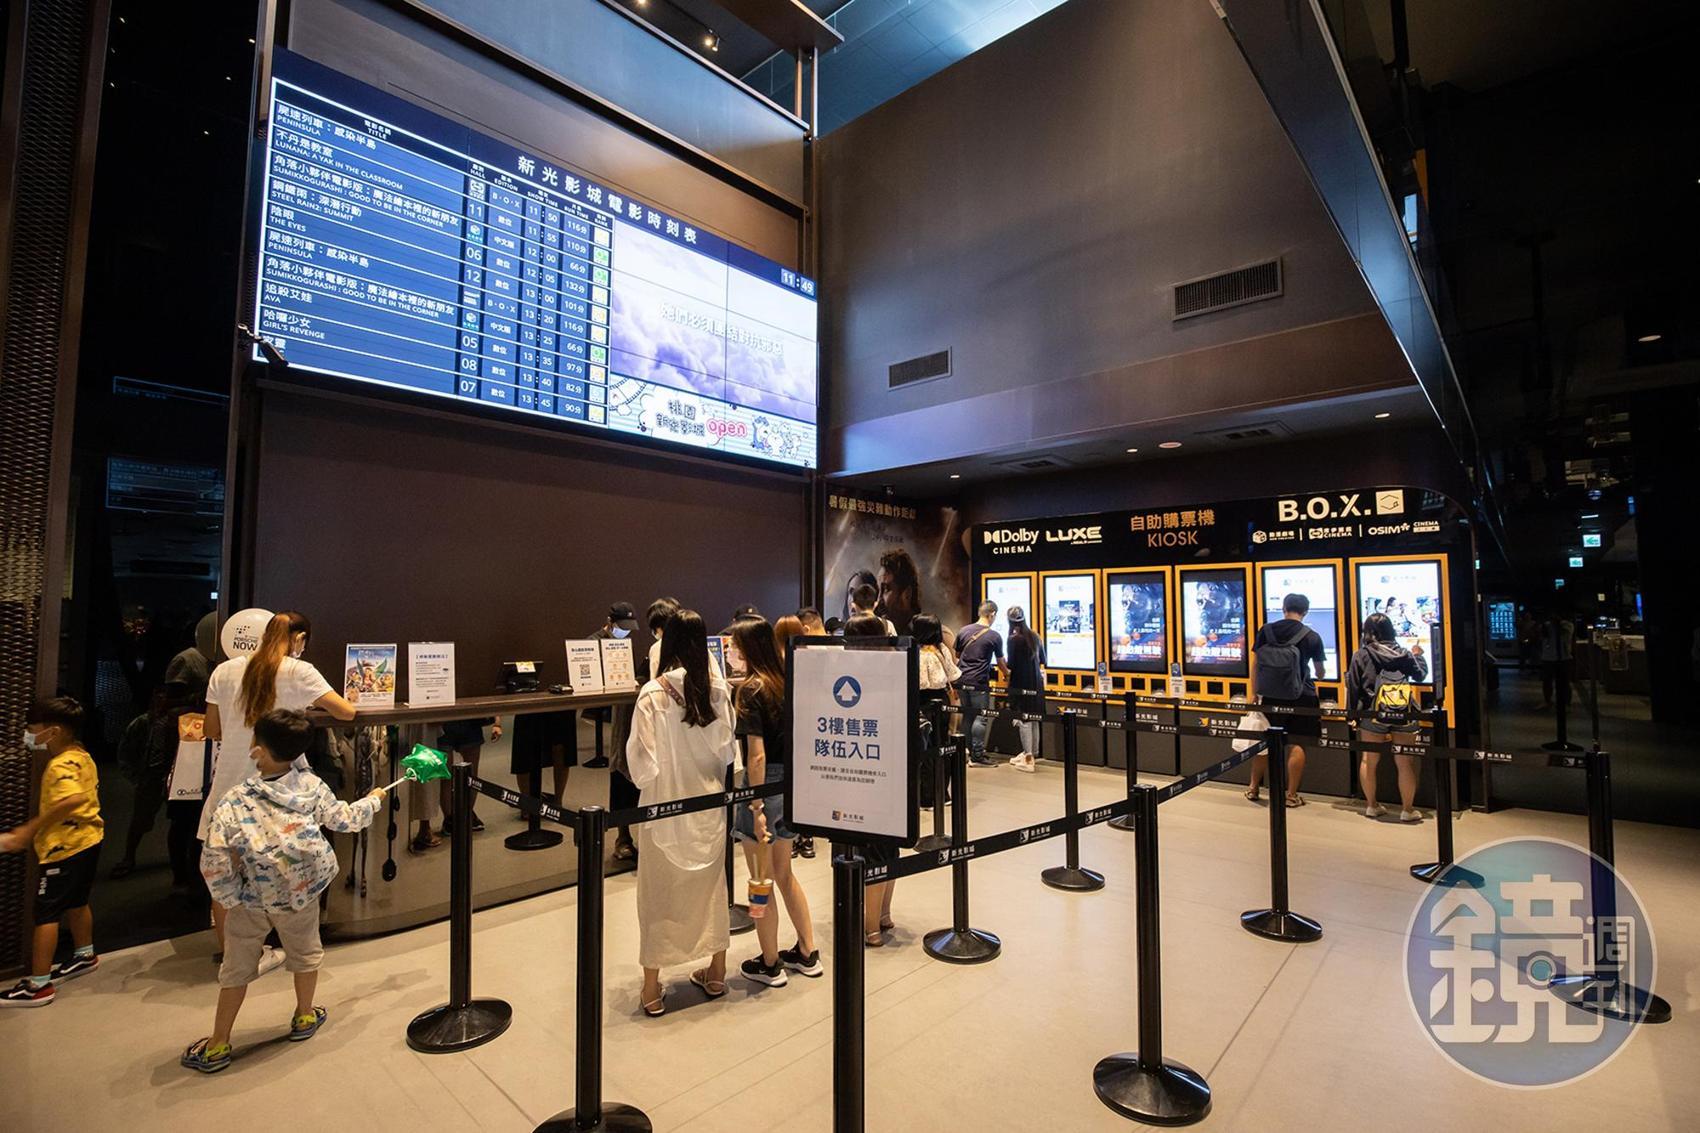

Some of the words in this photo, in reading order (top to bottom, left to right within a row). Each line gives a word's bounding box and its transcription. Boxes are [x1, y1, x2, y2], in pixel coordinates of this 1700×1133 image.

[277, 115, 320, 135] PENINSULA
[368, 128, 387, 140] TITLE
[277, 129, 333, 158] 不丹是教室
[275, 140, 310, 157] LUNANA:
[319, 156, 334, 166] YAK
[345, 165, 360, 175] THE
[361, 171, 403, 190] CLASSROOM
[470, 168, 485, 180] HALL
[494, 178, 519, 191] EDITION
[273, 165, 342, 193] SUMIKKOGURASHI
[348, 191, 370, 203] GOOD
[372, 198, 382, 207] TO
[383, 201, 392, 210] BE
[394, 204, 401, 213] IN
[402, 208, 416, 219] THE
[417, 213, 444, 228] CORNER
[518, 156, 697, 244] 新光影城電影時刻表
[527, 191, 544, 202] SHOW
[545, 198, 559, 208] TIME
[272, 191, 295, 203] STEEL
[324, 205, 354, 221] SUMMIT
[469, 203, 482, 218] 11
[576, 210, 589, 220] TIME
[270, 216, 286, 226] THE
[288, 221, 306, 232] EYES
[268, 241, 313, 259] PENINSULA
[466, 247, 482, 261] 06
[466, 269, 481, 283] 12
[265, 283, 312, 303] 追殺艾娃
[265, 295, 281, 303] AVA
[266, 268, 337, 292] SUMIKKOGURASHI
[342, 288, 365, 299] GOOD
[367, 294, 377, 302] TO
[378, 297, 387, 305] BE
[388, 299, 396, 307] IN
[398, 301, 411, 311] THE
[412, 305, 439, 318] CORNER
[564, 300, 585, 313] 101分
[263, 321, 288, 331] GIRL'S
[289, 325, 325, 339] REVENGE
[564, 321, 584, 333] 116分
[462, 336, 478, 349] 05
[567, 342, 583, 354] 66分
[461, 358, 477, 371] 08
[566, 362, 583, 373] 97分
[460, 380, 476, 392] 07
[565, 383, 582, 394] 82分
[565, 403, 582, 414] 90分
[707, 418, 747, 439] open
[1278, 494, 1372, 522] B.O.X.
[1130, 509, 1215, 532] 自助購票機
[1002, 528, 1040, 544] Dolby
[1046, 526, 1102, 543] LUXE
[1368, 525, 1401, 535] OSIM
[1148, 530, 1199, 547] KIOSK
[993, 546, 1032, 555] CINEMA
[233, 641, 258, 651] NOW
[817, 717, 879, 738] 3樓售票
[815, 739, 881, 761] 隊伍入口
